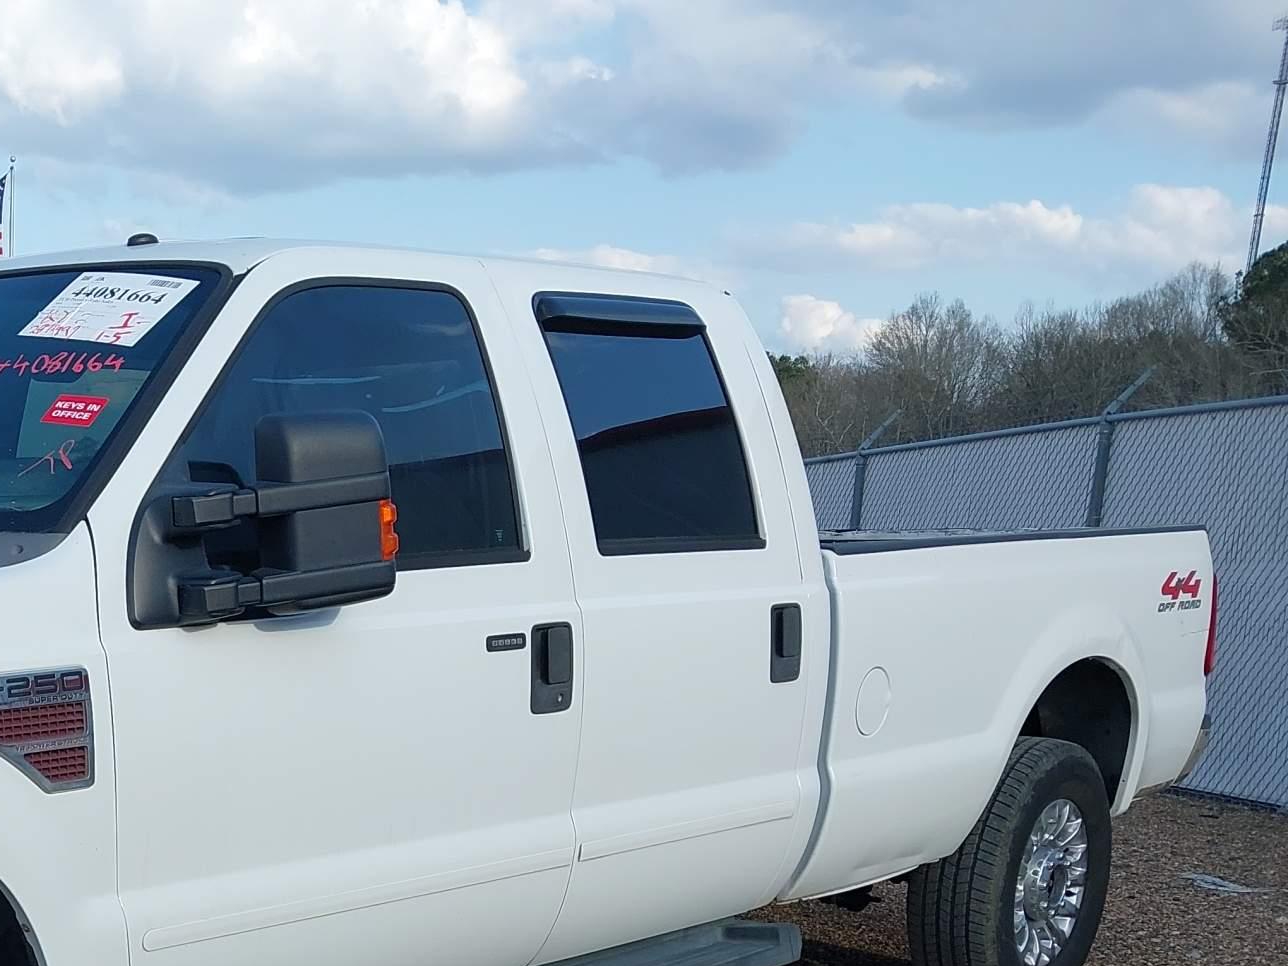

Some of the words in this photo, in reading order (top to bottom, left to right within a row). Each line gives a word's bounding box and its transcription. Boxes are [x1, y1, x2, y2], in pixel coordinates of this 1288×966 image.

[71, 285, 169, 305] 44081664
[55, 401, 86, 411] KEYS
[86, 403, 101, 412] IN
[51, 410, 92, 420] OFFICE
[1158, 602, 1176, 612] OFF
[1177, 600, 1201, 610] ROAD
[29, 696, 58, 704] SUPER
[60, 692, 85, 701] DUTY
